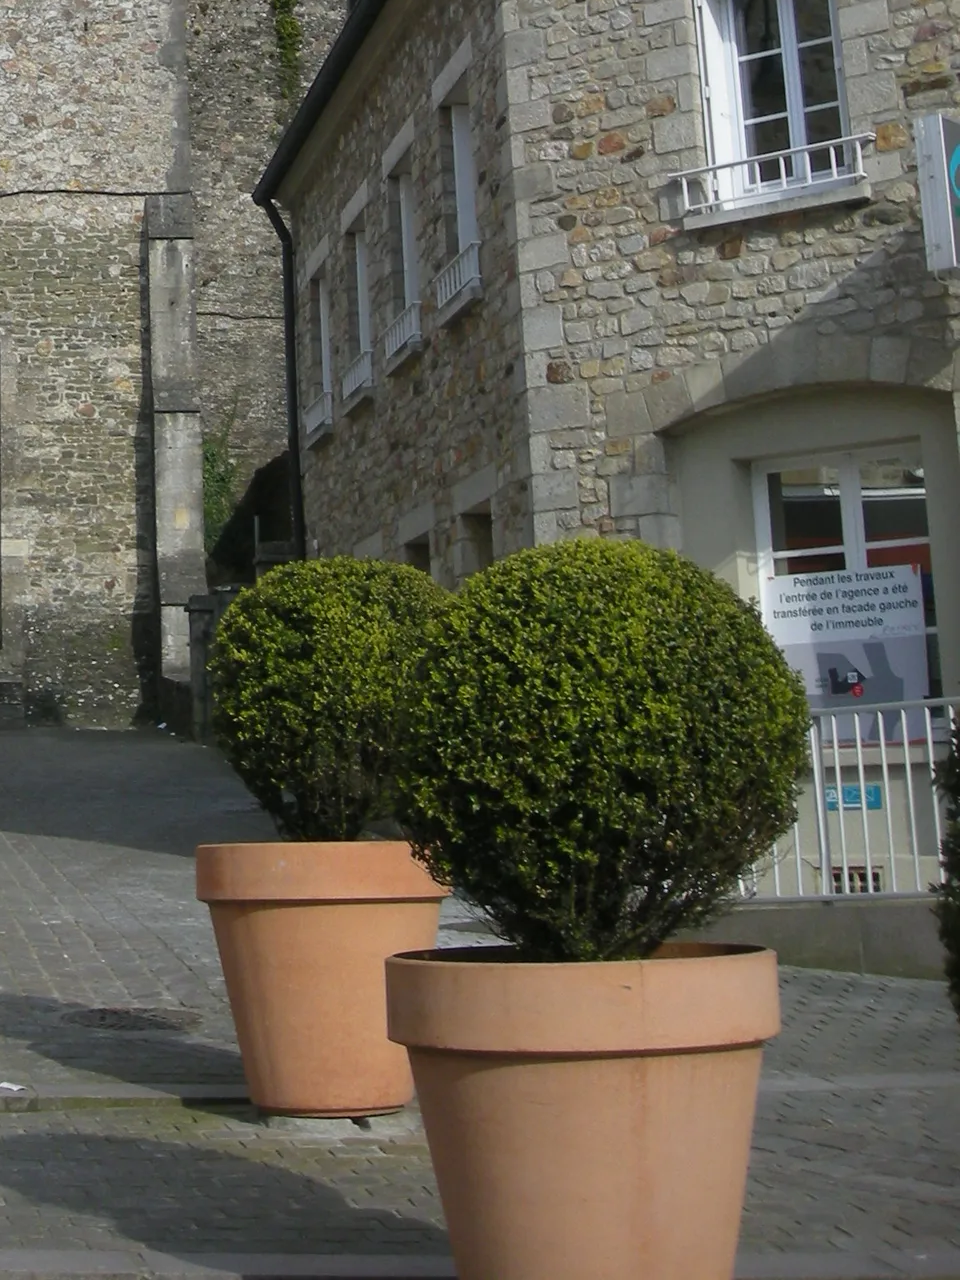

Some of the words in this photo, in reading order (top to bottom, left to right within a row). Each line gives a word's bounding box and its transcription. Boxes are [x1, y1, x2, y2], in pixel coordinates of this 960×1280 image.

[793, 576, 835, 588] Pendant
[837, 573, 853, 584] les
[855, 570, 895, 582] travaux
[779, 591, 818, 604] l'entrée
[820, 589, 833, 600] de
[835, 587, 880, 601] l'agence
[882, 586, 889, 595] a
[891, 583, 909, 594] été
[773, 604, 824, 619] transférée
[826, 606, 839, 616] en
[878, 598, 919, 613] gauche
[810, 620, 824, 632] de
[825, 616, 884, 631] l'immeuble
